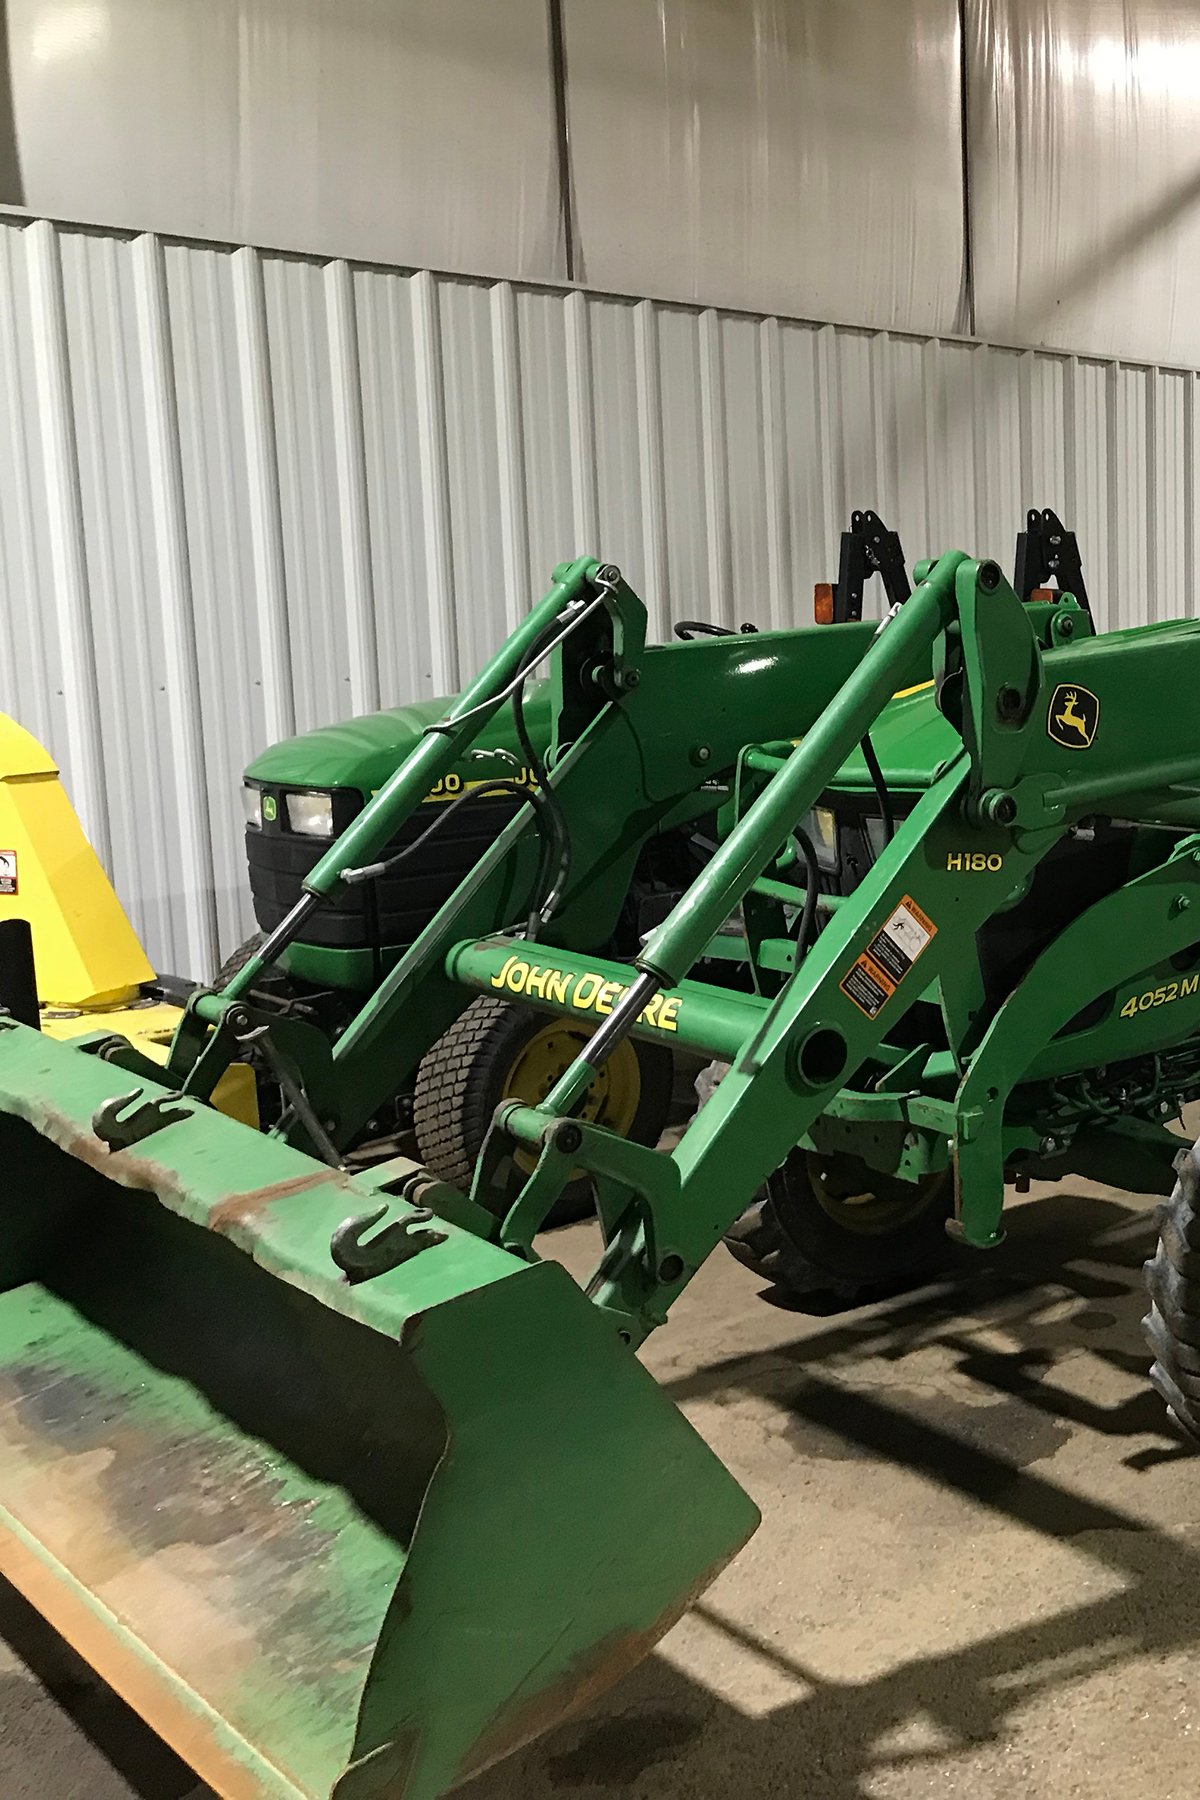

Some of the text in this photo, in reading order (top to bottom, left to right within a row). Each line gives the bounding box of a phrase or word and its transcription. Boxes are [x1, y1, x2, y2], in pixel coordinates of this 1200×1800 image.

[947, 852, 1003, 872] H180
[866, 965, 891, 992] WARNING
[491, 955, 683, 1032] JOHN DERE
